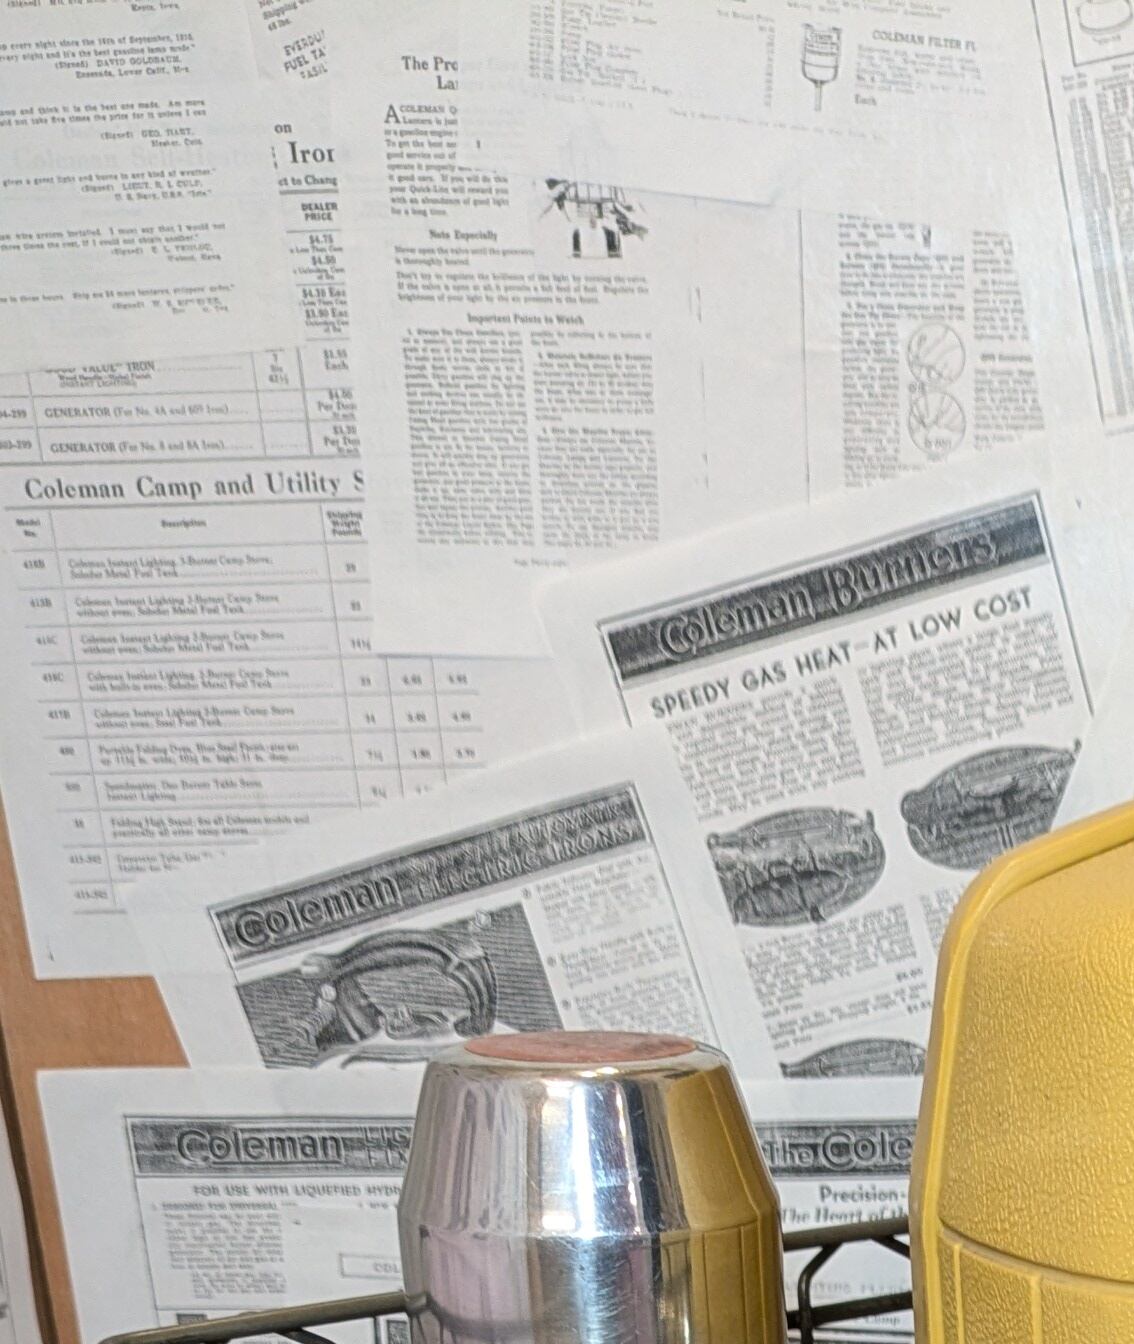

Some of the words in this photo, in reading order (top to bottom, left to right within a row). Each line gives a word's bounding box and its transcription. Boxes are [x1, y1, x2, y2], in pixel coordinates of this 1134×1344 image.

[311, 47, 327, 64] TA
[402, 56, 429, 72] The
[437, 76, 459, 90] La
[274, 122, 293, 135] on
[304, 174, 338, 189] Chang
[24, 477, 125, 501] Coleman
[136, 475, 203, 502] Camp
[214, 474, 255, 497] and
[264, 471, 341, 498] Utility
[656, 584, 818, 662] Coleman
[821, 529, 1001, 612] Burners
[650, 679, 730, 719] SPEEDY
[742, 664, 788, 693] GAS
[910, 606, 962, 643] LOW
[975, 585, 1032, 623] COST
[233, 873, 400, 952] Coleman
[176, 1127, 345, 1162] Coleman
[822, 1129, 914, 1172] Cole
[819, 1184, 907, 1204] Precision-
[781, 1207, 811, 1225] The
[815, 1206, 863, 1222] Heart
